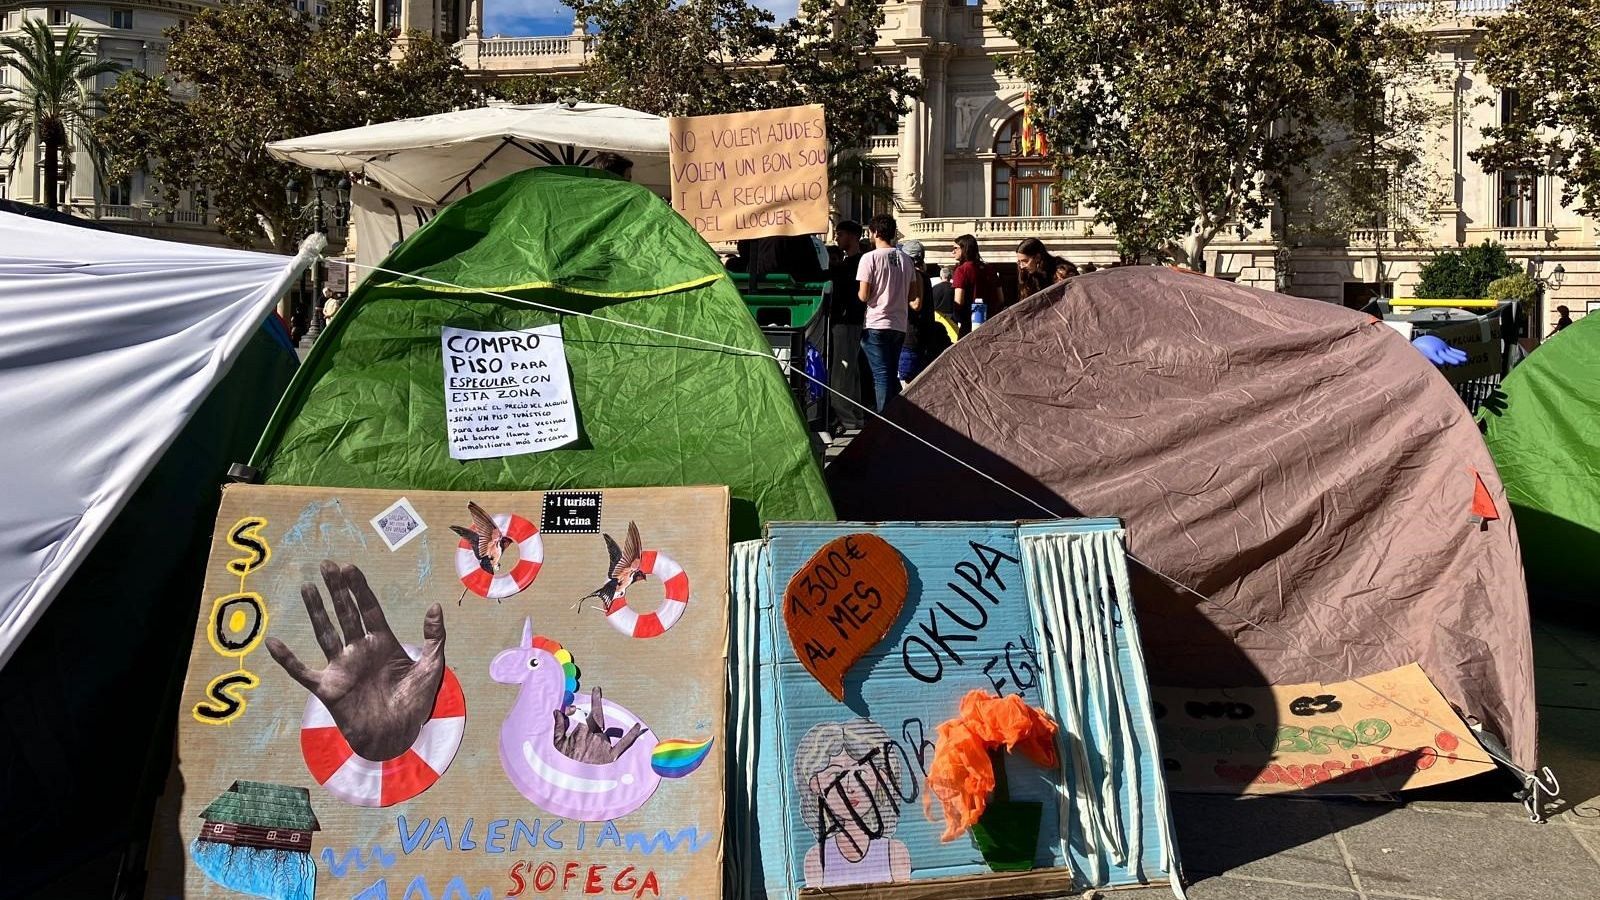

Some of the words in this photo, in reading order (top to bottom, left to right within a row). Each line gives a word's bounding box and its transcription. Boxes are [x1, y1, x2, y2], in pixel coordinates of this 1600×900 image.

[669, 130, 697, 154] NO
[711, 126, 762, 149] VOLEM
[766, 118, 824, 143] AJUDES
[672, 161, 727, 184] VOLEM
[735, 158, 756, 177] UN
[762, 152, 792, 174] BON
[798, 149, 827, 168] SOU
[680, 191, 688, 211] I
[699, 189, 723, 210] LA
[733, 176, 824, 207] REGULACIÓ
[694, 216, 723, 234] DEL
[735, 209, 795, 230] LLOGUER
[447, 334, 540, 353] COMPRO
[511, 360, 548, 371] PARA
[450, 376, 518, 388] ESPECULAR
[522, 374, 551, 385] CON
[452, 391, 490, 403] ESTA
[497, 388, 541, 399] ZONA
[475, 424, 499, 433] echar
[556, 496, 561, 506] 1
[563, 496, 596, 506] turista
[556, 516, 561, 525] 1
[563, 516, 591, 525] veina
[193, 517, 271, 726] SOS
[903, 540, 1019, 684] OKUPA
[803, 638, 837, 670] AL
[827, 580, 883, 640] MES
[1289, 694, 1343, 717] ES
[397, 815, 621, 855] VALENCIA
[506, 860, 660, 898] S'OFEGA
